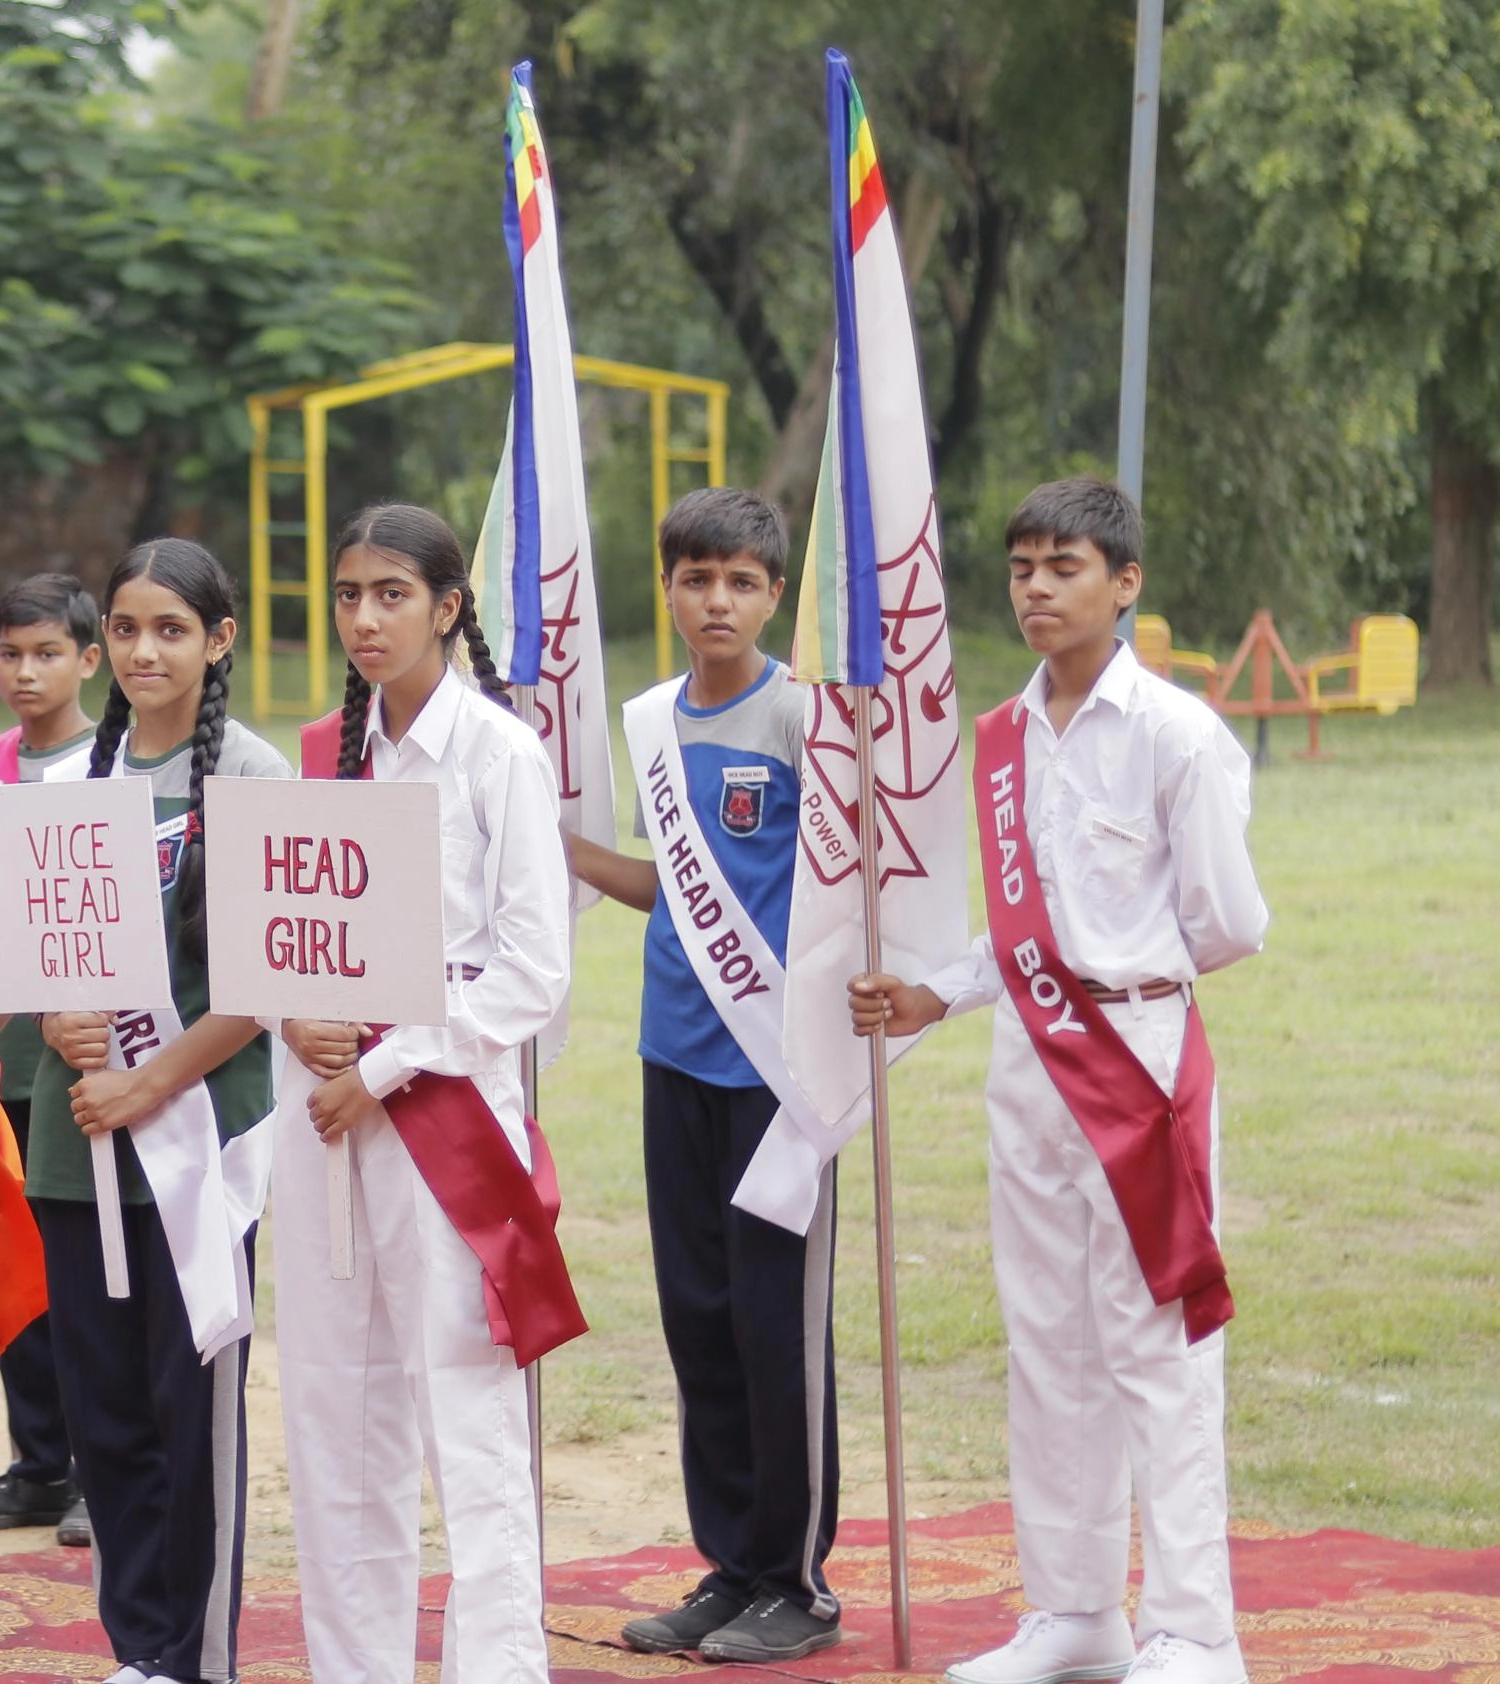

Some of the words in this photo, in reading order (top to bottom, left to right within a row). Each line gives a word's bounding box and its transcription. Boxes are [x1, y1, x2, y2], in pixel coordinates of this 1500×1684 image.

[25, 823, 113, 870] VICE
[803, 792, 847, 861] Power
[264, 835, 369, 899] HEAD
[647, 748, 681, 838] VICE
[668, 833, 722, 931] HEAD
[706, 928, 770, 1003] BOY
[990, 762, 1023, 906] HEAD
[1013, 937, 1087, 1034] BOY
[25, 877, 120, 924] HEAD
[41, 931, 116, 978] GIRL
[265, 916, 366, 978] GIRL
